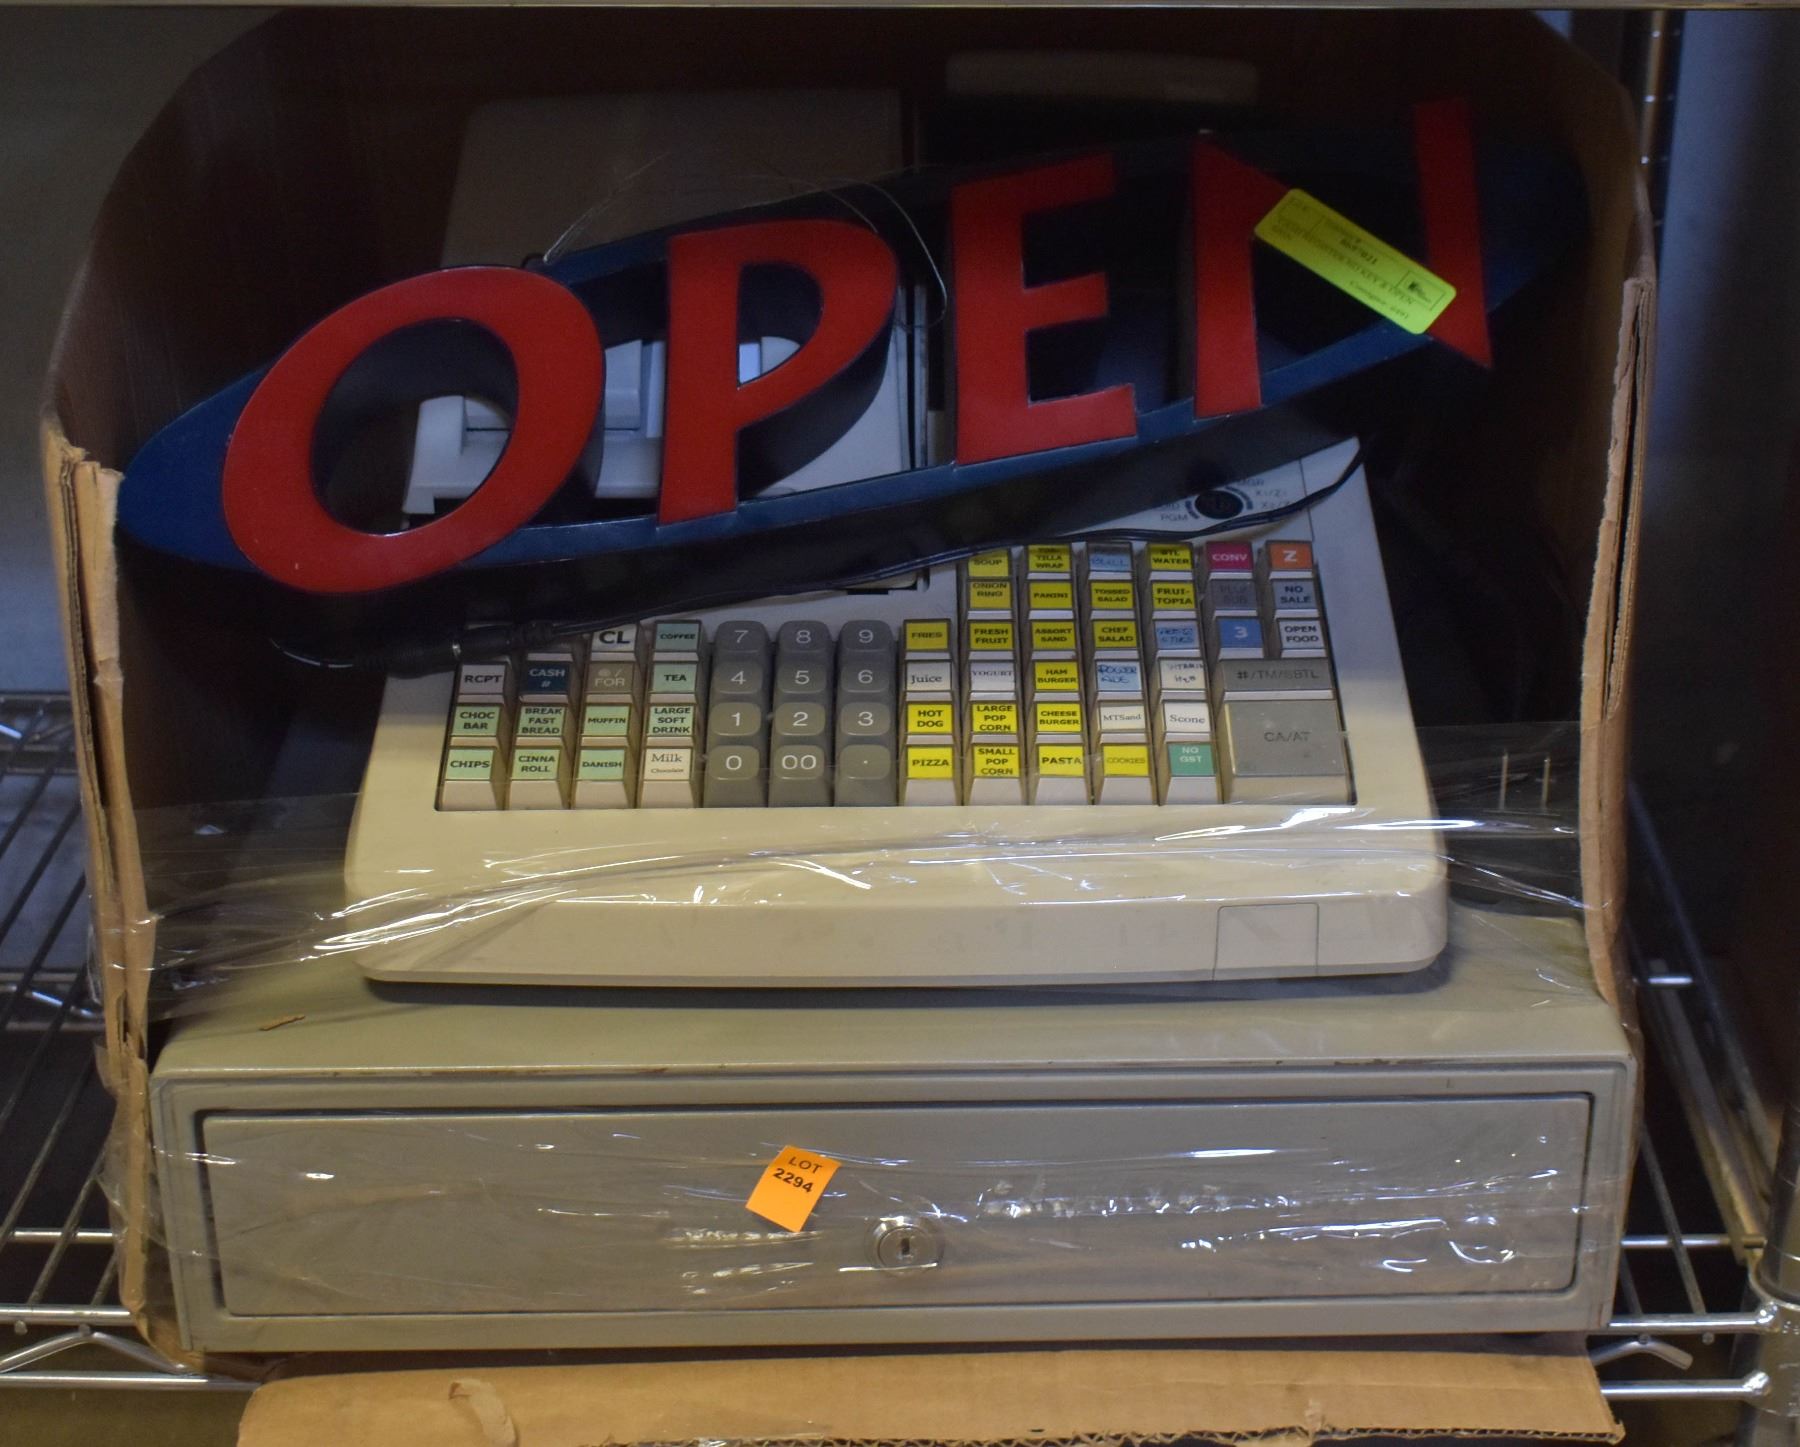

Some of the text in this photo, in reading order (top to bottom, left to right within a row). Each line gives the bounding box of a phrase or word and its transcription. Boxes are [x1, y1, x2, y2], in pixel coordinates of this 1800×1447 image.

[222, 98, 1493, 595] OPEN
[1212, 553, 1248, 561] CONV
[1284, 551, 1297, 561] Z
[1156, 597, 1193, 605] TOPIA
[734, 630, 749, 644] 7
[795, 629, 811, 644] 8
[858, 629, 874, 643] 9
[1234, 626, 1249, 639] 3
[599, 630, 631, 645] CL
[1286, 635, 1319, 643] FOOD
[529, 668, 565, 678] CASH
[664, 673, 687, 682] TEA
[730, 670, 746, 685] 4
[794, 670, 810, 685] 5
[857, 669, 873, 684] 6
[464, 674, 502, 684] RCPT
[595, 677, 625, 687] FOR
[911, 674, 943, 684] Juice
[459, 711, 495, 720] CHOC
[524, 707, 562, 715] BREAK
[653, 707, 691, 715] LARGE
[917, 709, 944, 718] HOT
[528, 717, 556, 725] FAST
[657, 716, 686, 724] SOFT
[731, 712, 741, 726] 1
[792, 711, 809, 726] 2
[857, 711, 874, 726] 3
[984, 714, 1006, 722] POP
[1170, 714, 1206, 724] Scone
[463, 722, 488, 730] BAR
[917, 720, 944, 728] DOG
[521, 726, 560, 734] BREAD
[652, 726, 690, 734] DRINK
[1264, 731, 1311, 742] CA/AT
[1182, 746, 1199, 754] NO
[518, 755, 556, 763] CINNA
[651, 753, 682, 763] Milk
[781, 754, 817, 770] 00
[912, 758, 949, 767] PIZZA
[1042, 756, 1082, 765] PASTA
[1179, 755, 1201, 763] GST
[450, 760, 490, 769] CHIPS
[582, 760, 622, 768] DANISH
[725, 755, 742, 771] 0
[521, 765, 551, 773] ROLL
[981, 767, 1013, 775] CORN
[789, 1156, 823, 1174] LOT
[773, 1167, 814, 1193] 2294
